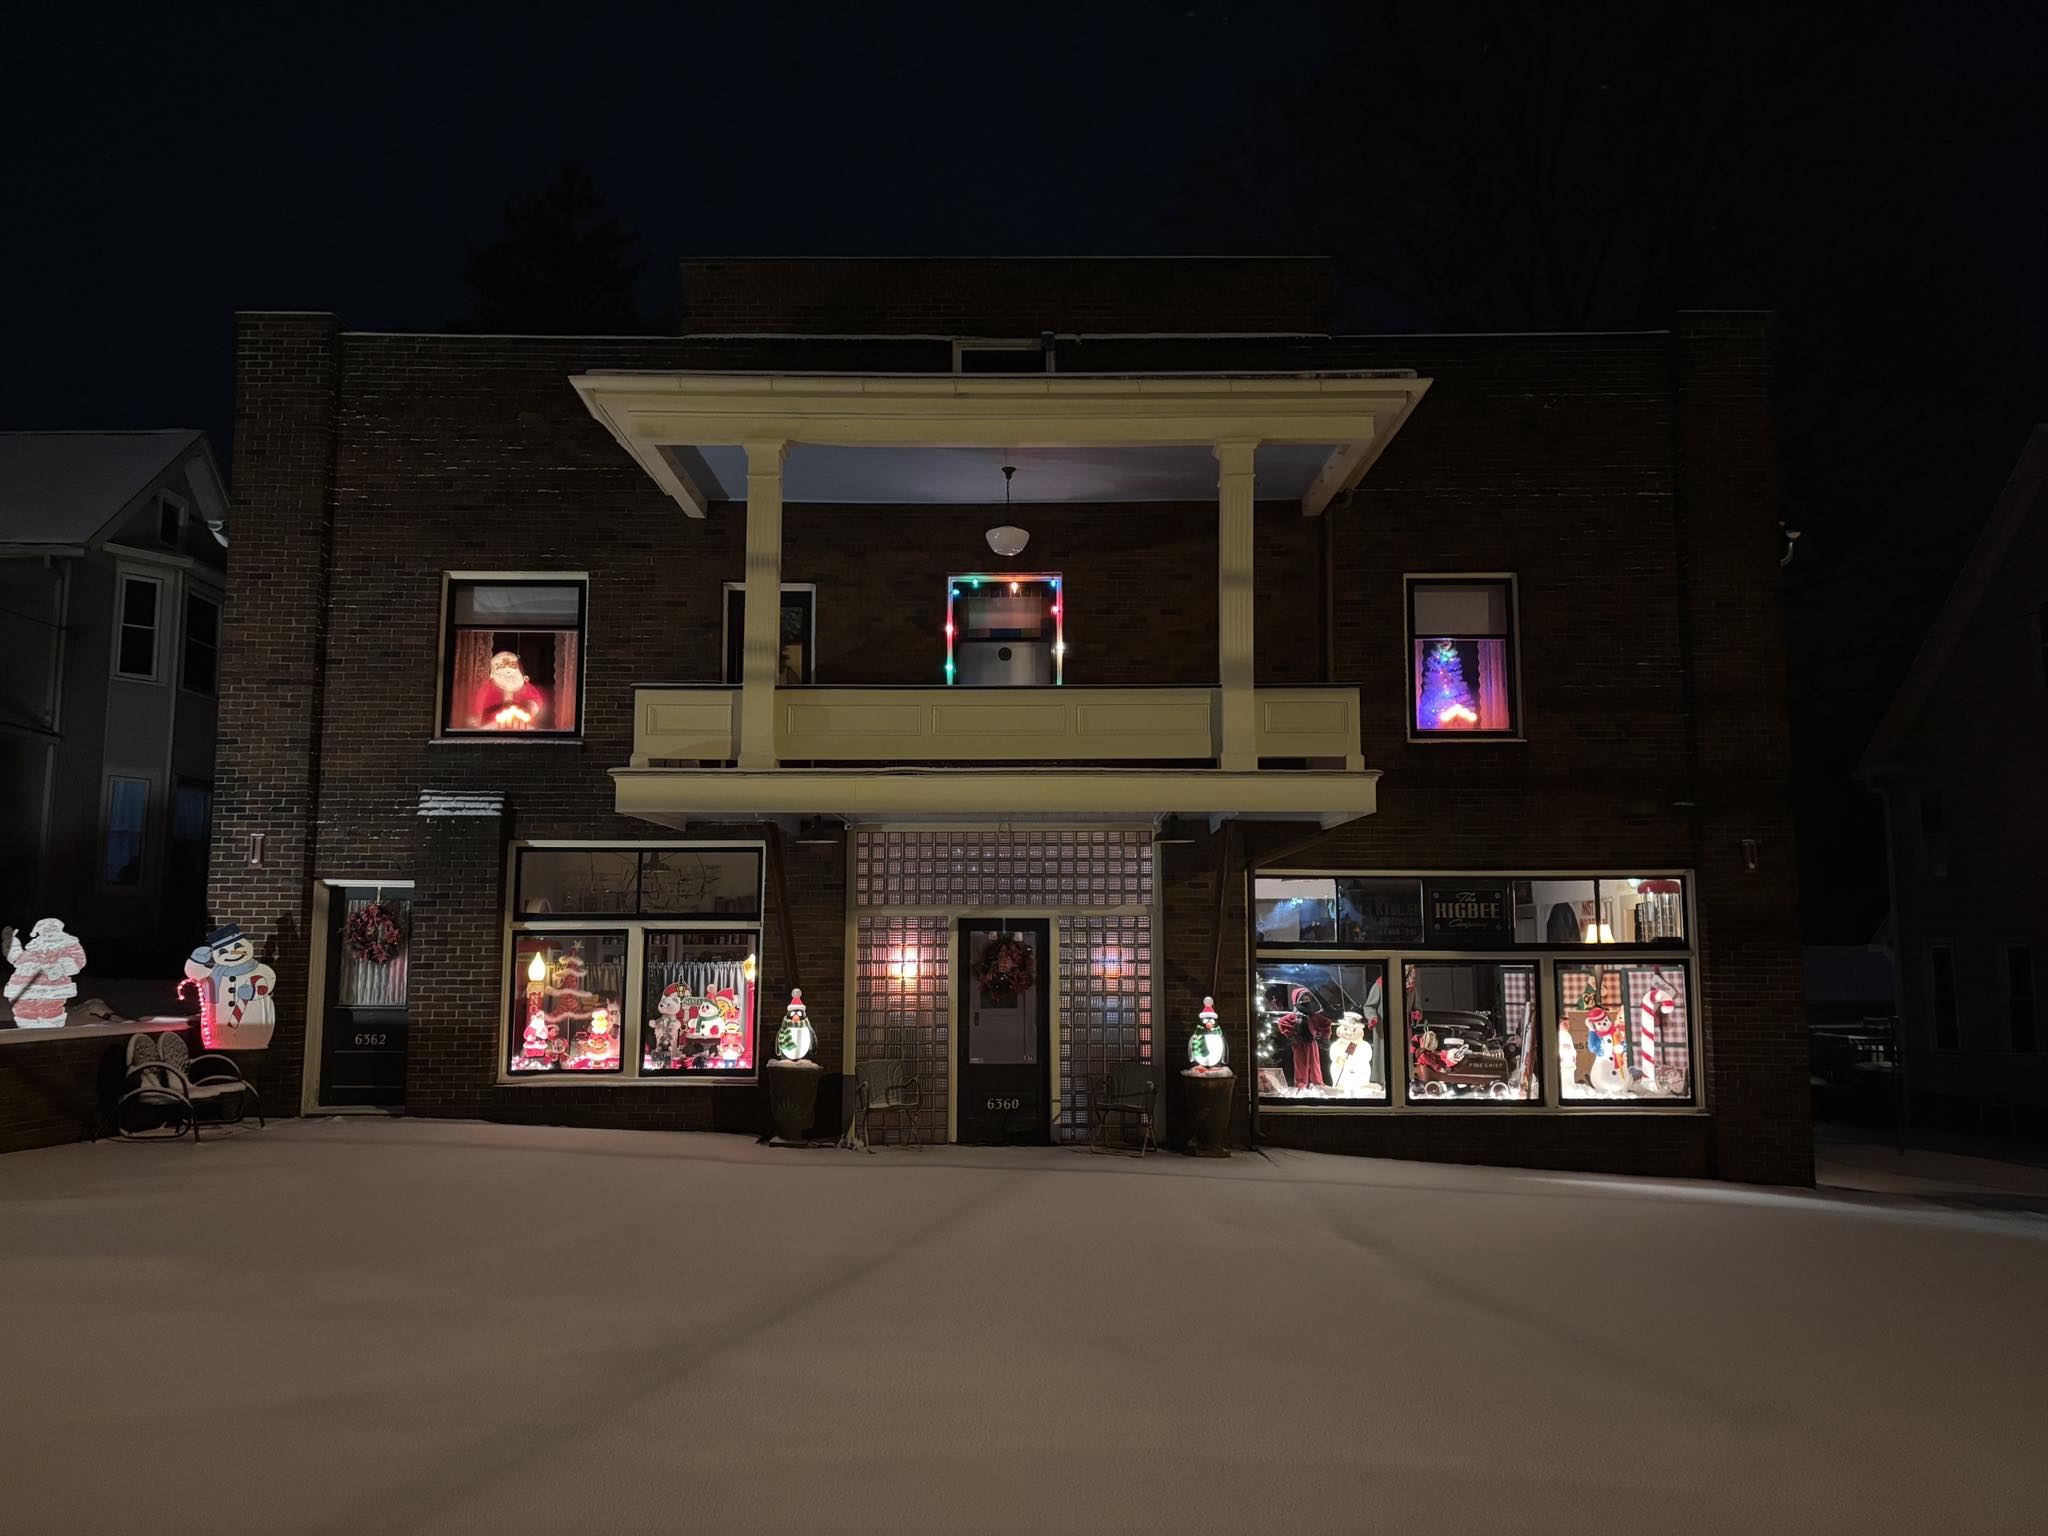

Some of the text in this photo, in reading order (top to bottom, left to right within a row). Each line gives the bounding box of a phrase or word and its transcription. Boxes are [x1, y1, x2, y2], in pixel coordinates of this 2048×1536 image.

[1456, 892, 1477, 902] The
[1435, 902, 1500, 918] HIGBEE
[354, 1033, 386, 1046] 6362
[986, 1098, 1020, 1110] 6360
